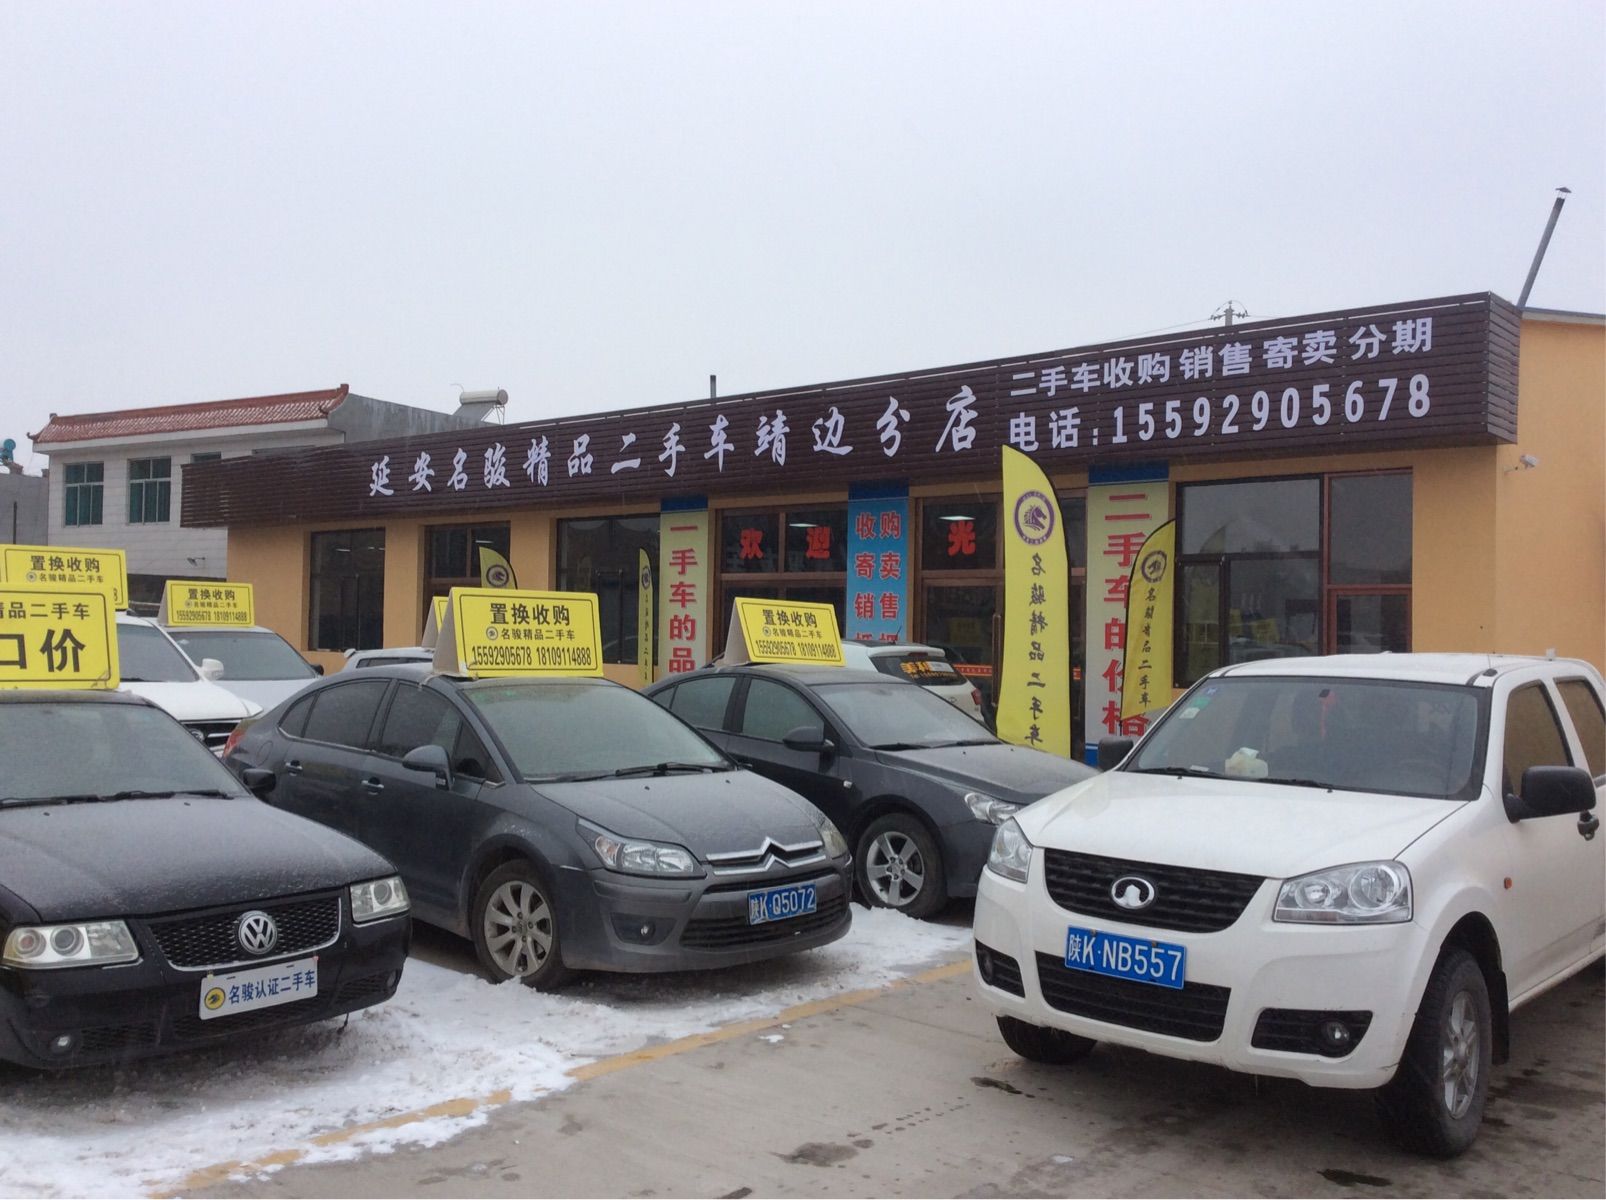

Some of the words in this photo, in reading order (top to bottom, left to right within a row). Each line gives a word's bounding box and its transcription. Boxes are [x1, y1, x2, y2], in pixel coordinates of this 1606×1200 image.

[1010, 352, 1171, 397] 二手车收购
[1179, 342, 1253, 381] 销售
[1262, 330, 1337, 369] 寄卖
[1348, 317, 1433, 361] 分期
[369, 384, 978, 497] 延安名骏精品二手车靖边分店
[855, 510, 901, 540] 收购
[947, 520, 976, 556] 光
[30, 555, 100, 573] 置换收购
[855, 550, 901, 579] 寄卖
[188, 588, 235, 601] 置换收购
[669, 525, 698, 673] 一手车的品
[854, 592, 899, 620] 销售
[490, 602, 570, 626] 置换收购
[762, 609, 818, 628] 置换收购
[501, 628, 576, 641] 名骏精品二手车
[472, 645, 532, 666] 15592905678
[536, 647, 591, 666] 18109114888
[228, 969, 316, 1005] 名骏认证二手车
